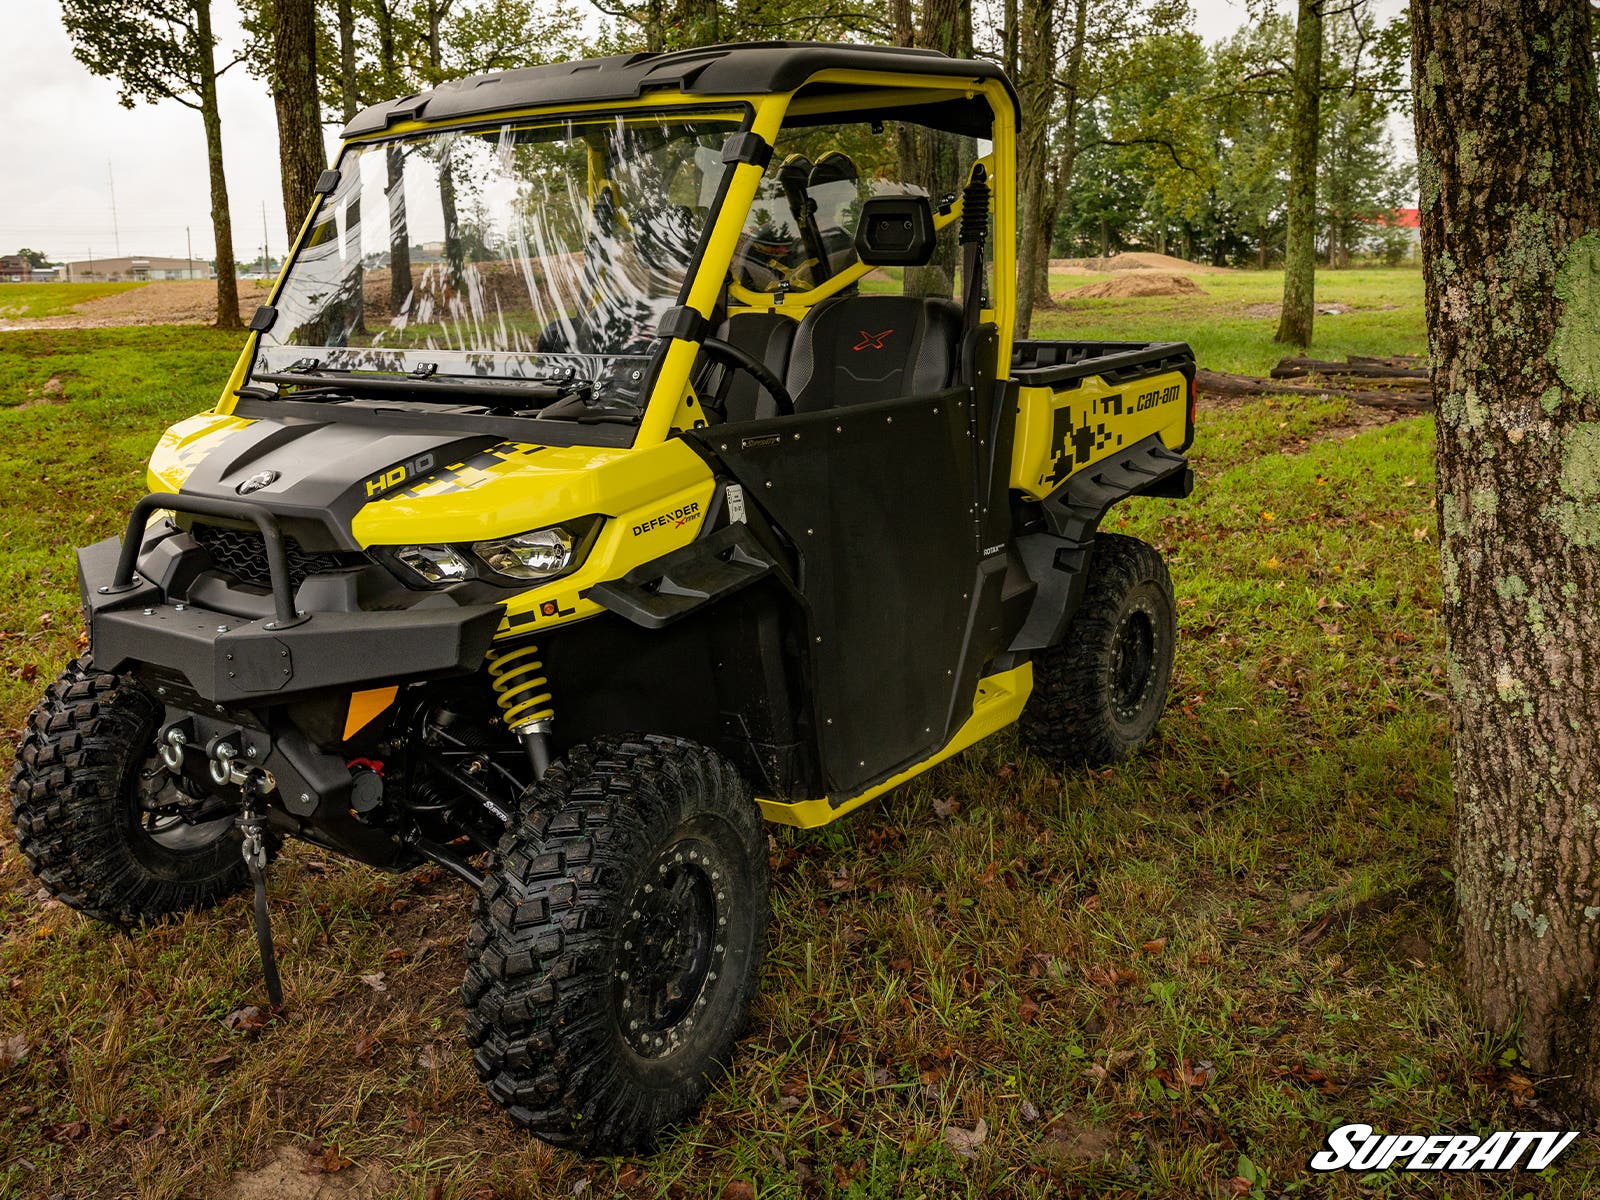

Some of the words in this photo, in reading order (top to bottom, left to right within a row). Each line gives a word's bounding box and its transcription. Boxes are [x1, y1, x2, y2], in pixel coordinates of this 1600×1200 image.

[1136, 385, 1180, 412] can-am
[365, 453, 434, 497] HD10
[632, 502, 699, 536] DEFENDER
